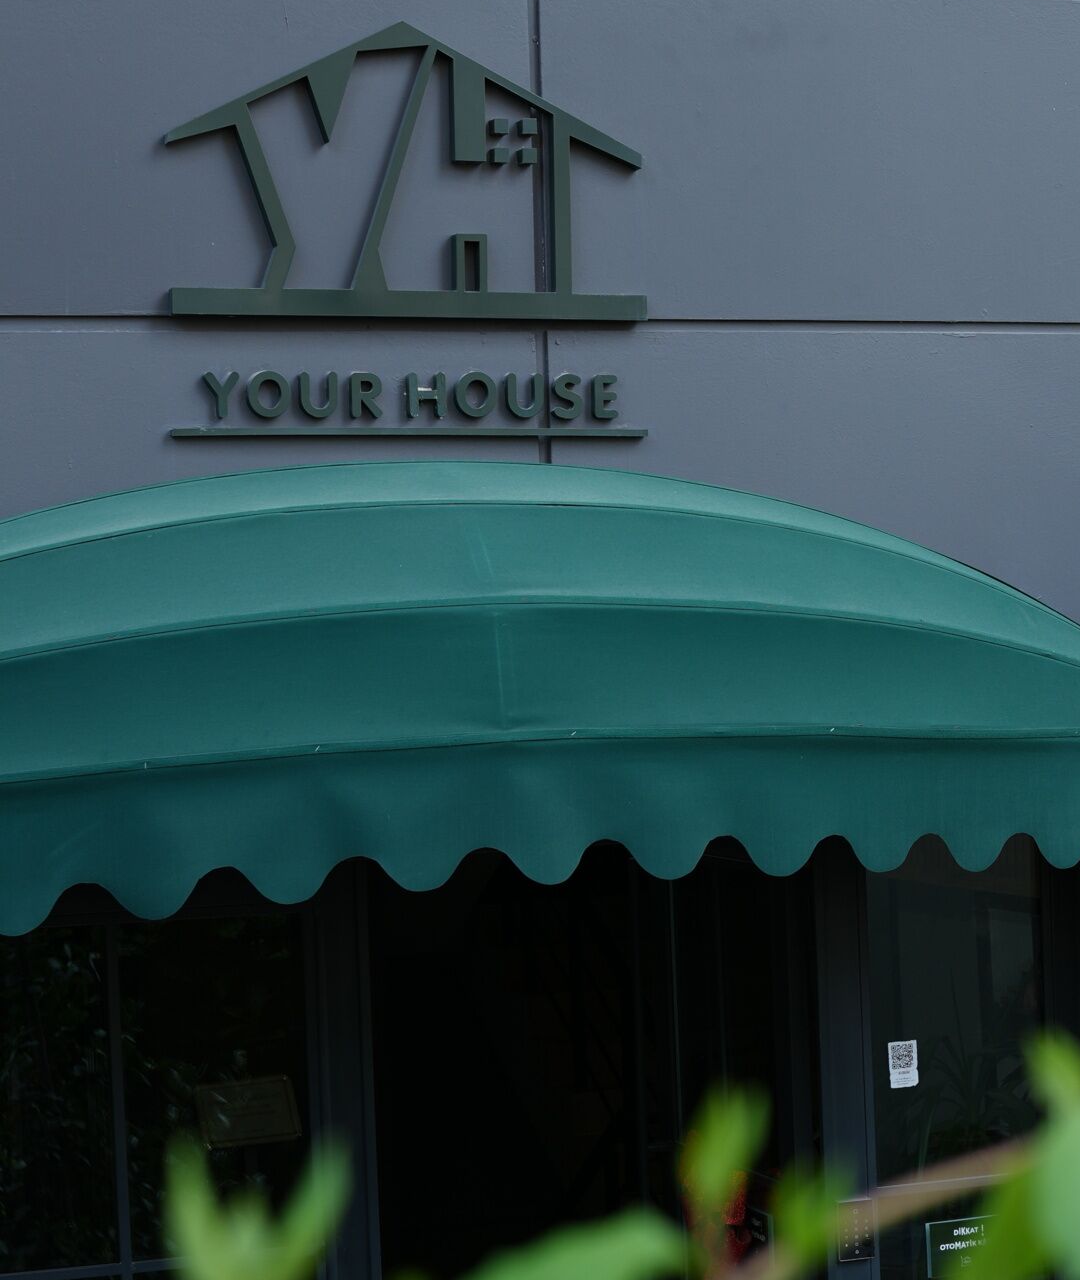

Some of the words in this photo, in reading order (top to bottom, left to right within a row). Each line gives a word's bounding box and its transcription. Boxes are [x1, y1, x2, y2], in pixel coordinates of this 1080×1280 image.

[202, 370, 383, 420] YOUR
[405, 370, 620, 421] HOUSE
[954, 1227, 979, 1236] DİKKAT
[940, 1240, 977, 1250] OTOMATİK
